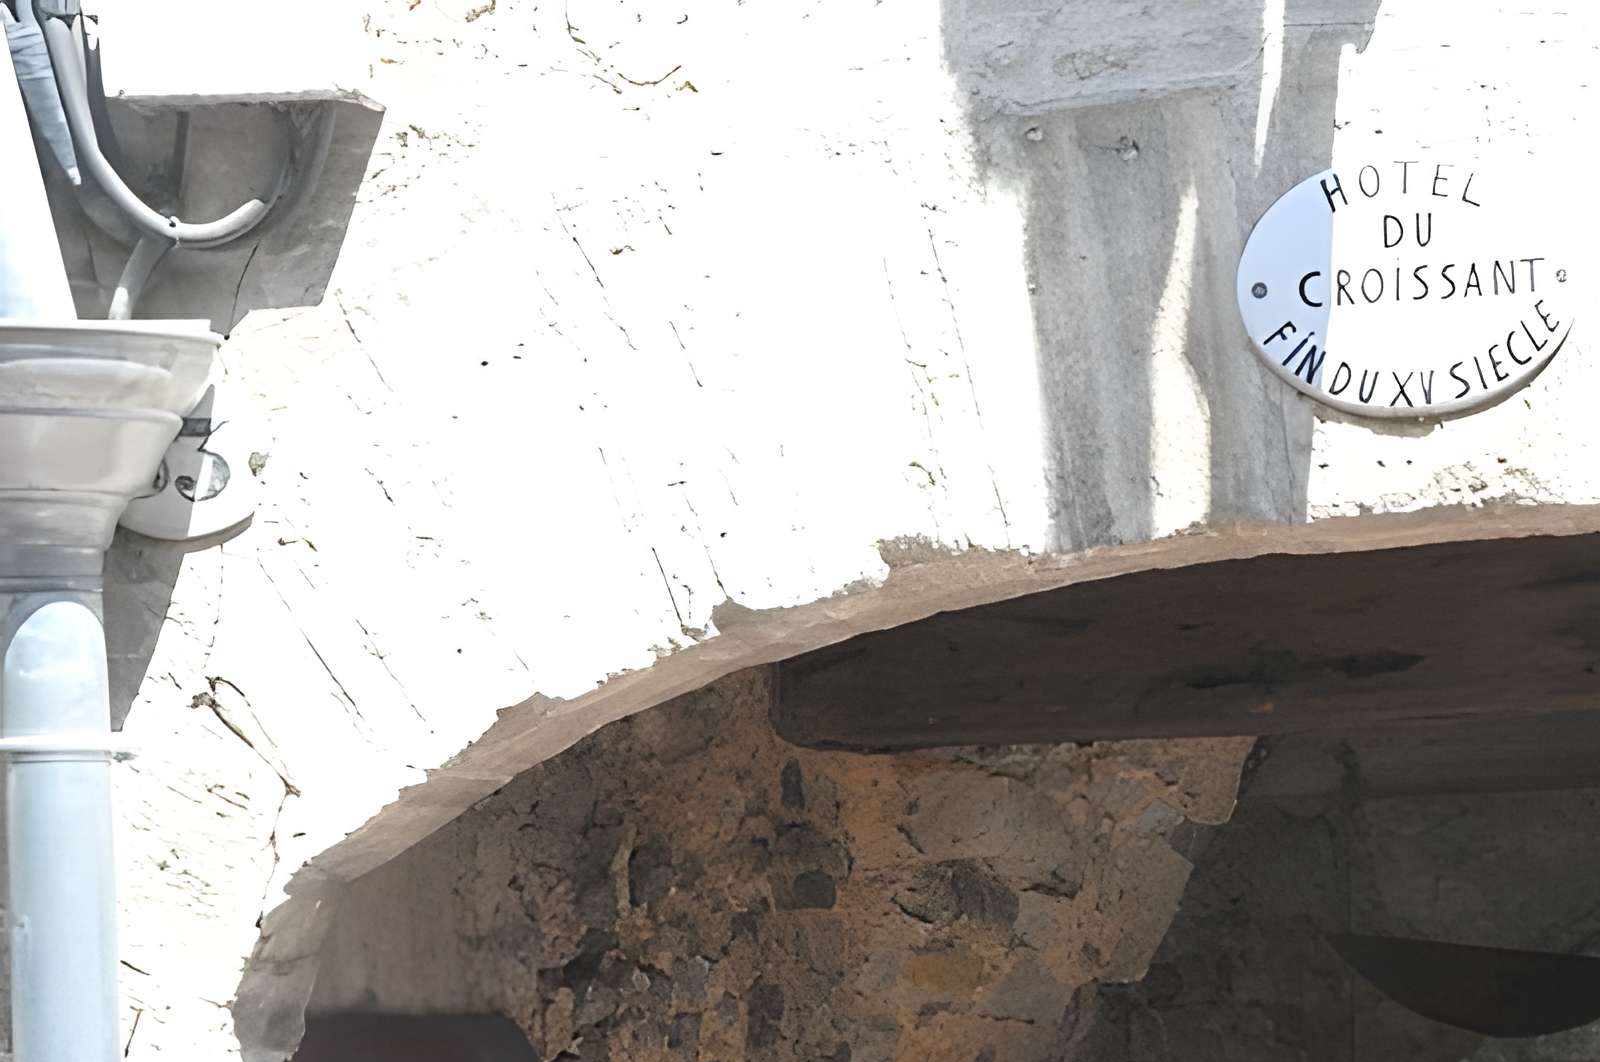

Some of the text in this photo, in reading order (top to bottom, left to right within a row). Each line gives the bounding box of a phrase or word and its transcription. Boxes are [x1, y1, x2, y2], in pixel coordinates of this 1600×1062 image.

[1320, 161, 1480, 212] HOTEL
[1383, 213, 1432, 248] DU
[1299, 260, 1545, 307] CROISSANT
[1263, 300, 1560, 407] FIN DU XV SIECLE
